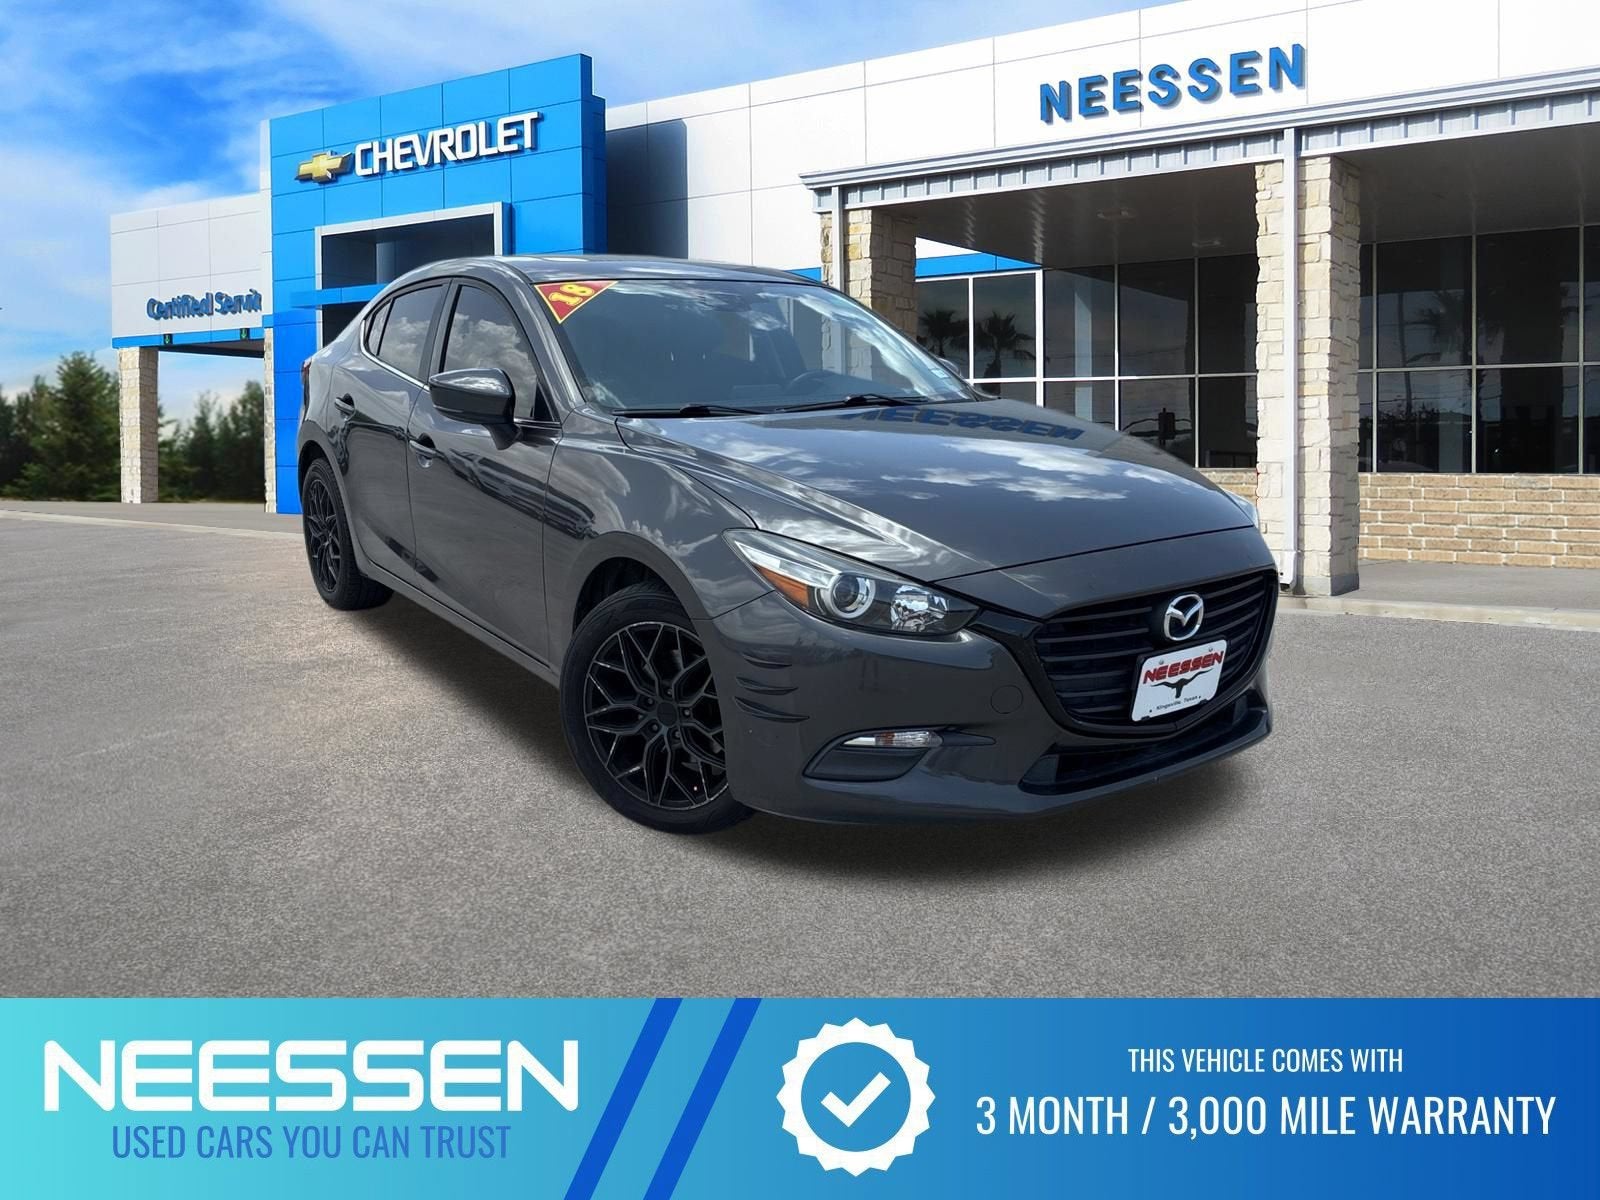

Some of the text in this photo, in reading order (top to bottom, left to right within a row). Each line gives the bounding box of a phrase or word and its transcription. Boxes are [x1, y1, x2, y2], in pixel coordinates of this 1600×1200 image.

[1040, 43, 1306, 125] NEESSEN
[355, 111, 541, 177] CHEVROLET
[147, 292, 214, 320] Certified
[548, 284, 595, 307] 18
[1142, 650, 1224, 685] NEESSEN
